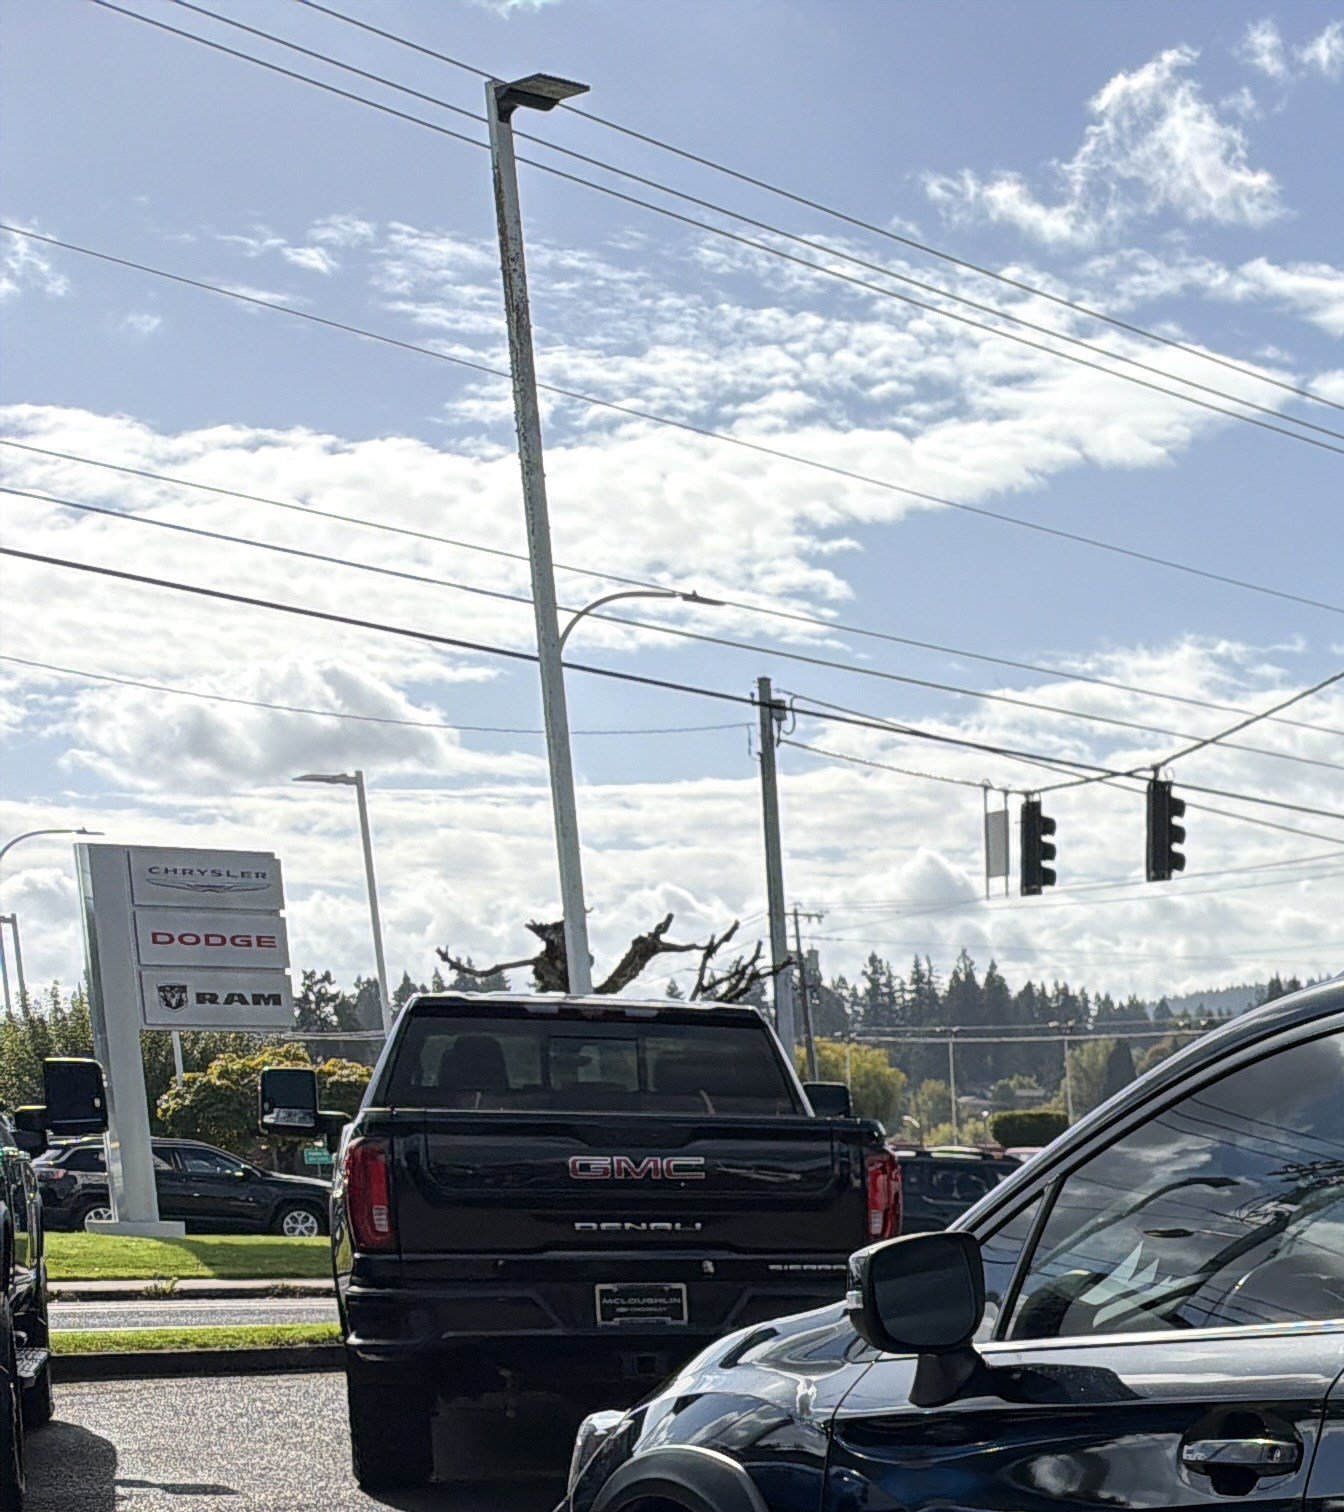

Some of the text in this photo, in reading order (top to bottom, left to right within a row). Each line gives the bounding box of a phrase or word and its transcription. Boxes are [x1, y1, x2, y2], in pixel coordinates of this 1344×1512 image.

[148, 866, 268, 879] CHRYSLER
[151, 932, 277, 948] DODGE
[195, 992, 282, 1006] RAM
[568, 1156, 705, 1179] GMC
[574, 1222, 702, 1231] DENALI
